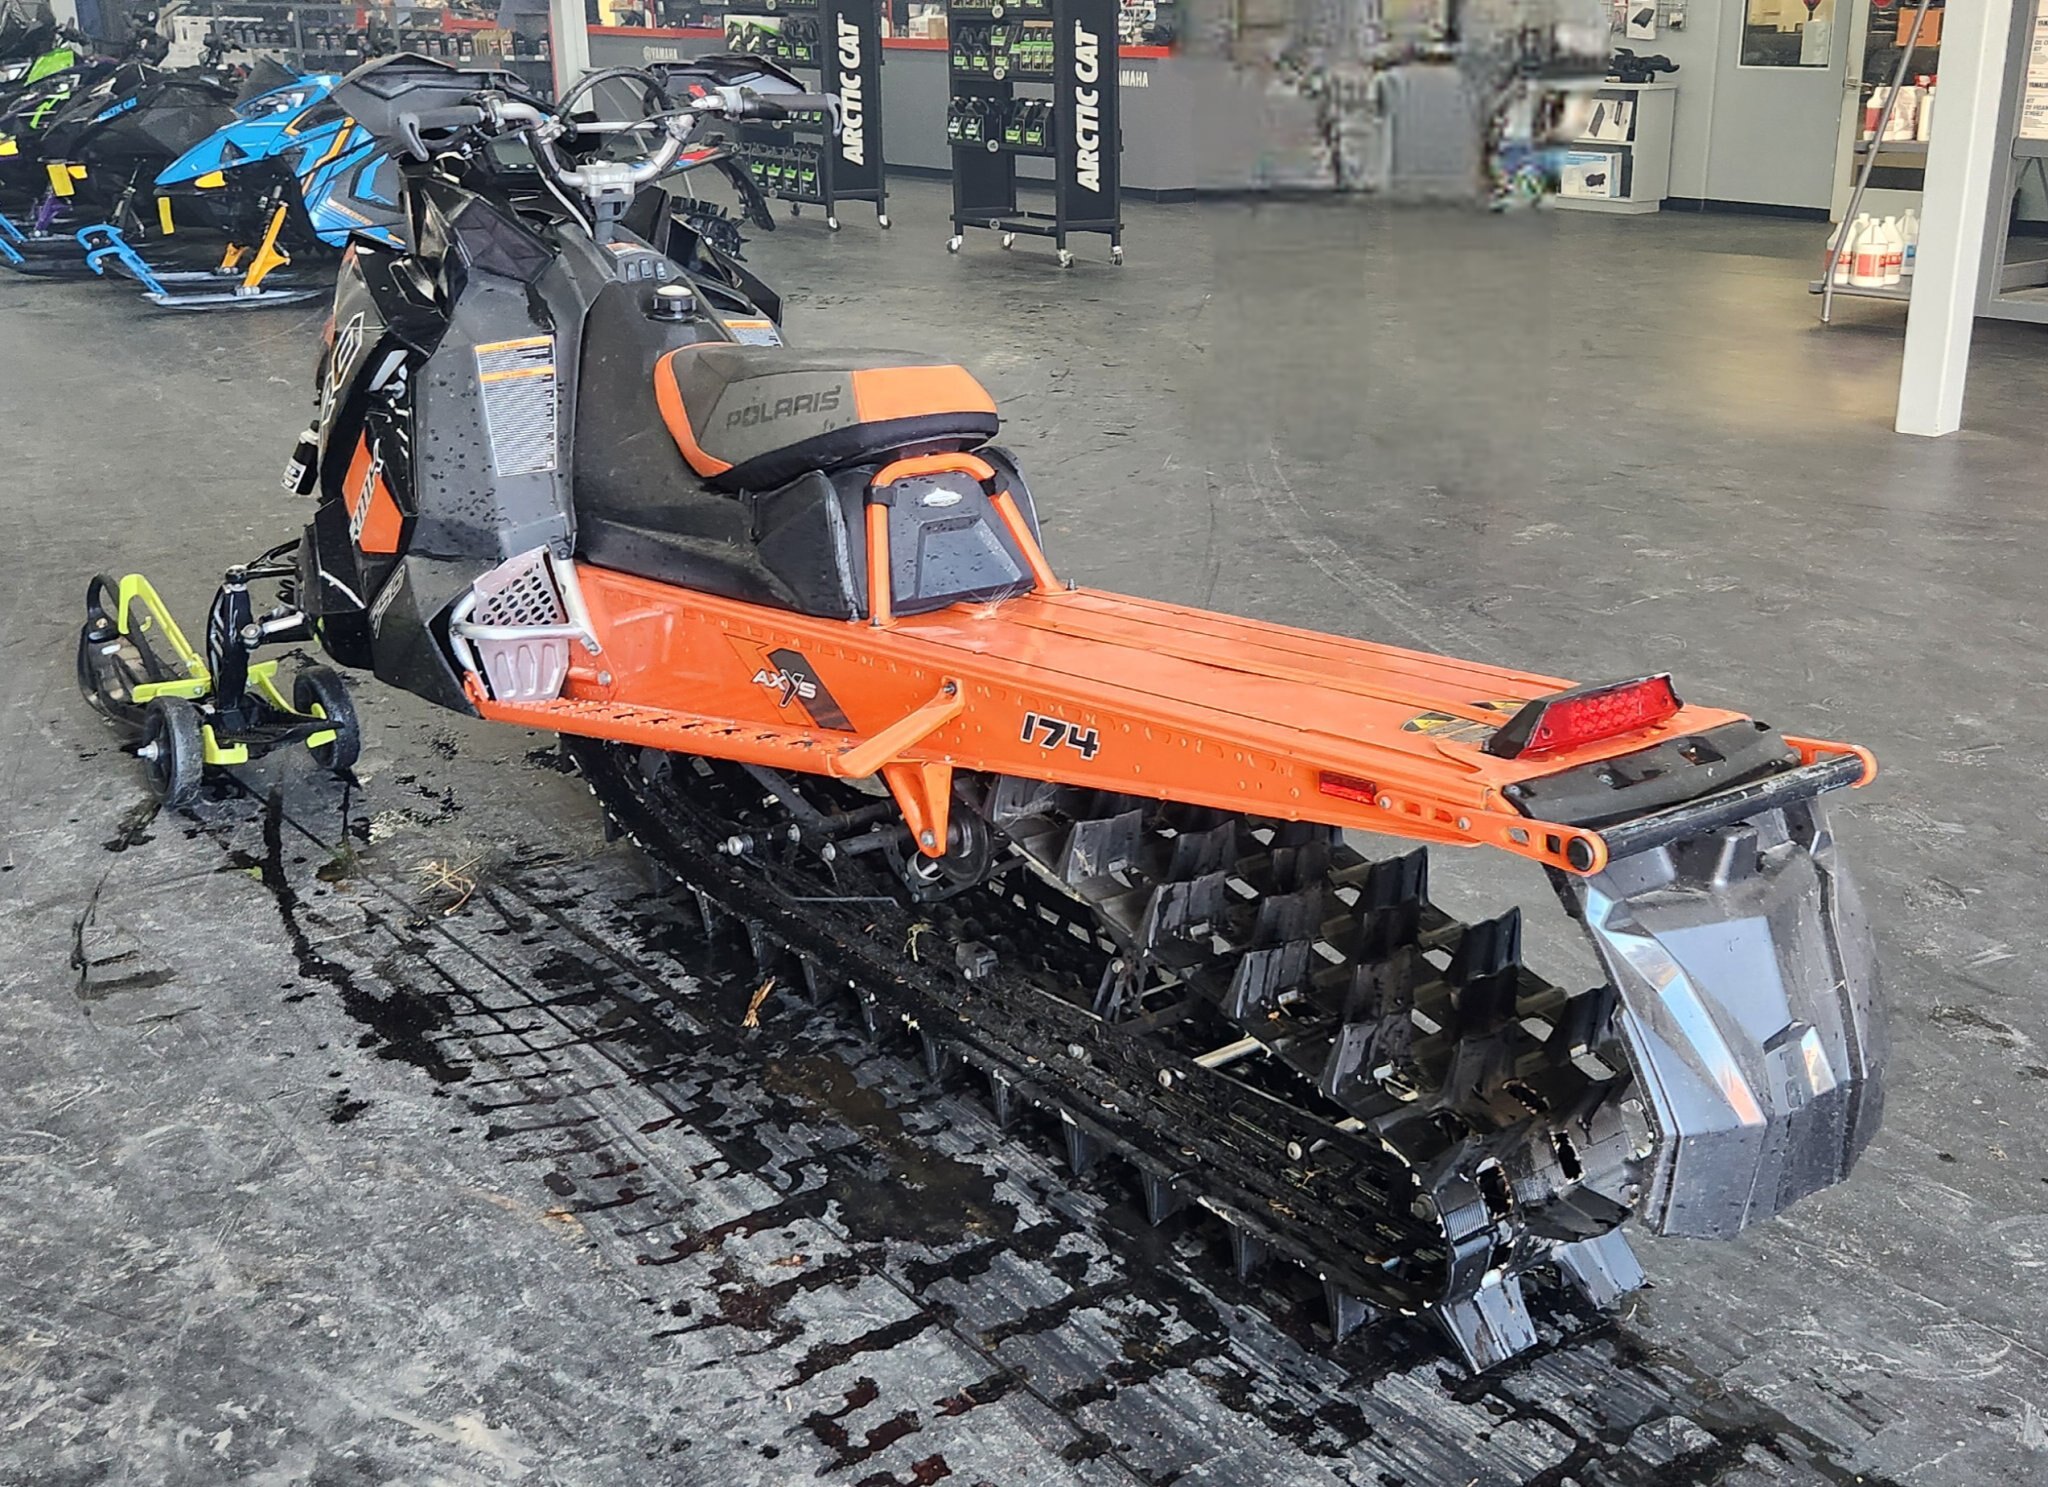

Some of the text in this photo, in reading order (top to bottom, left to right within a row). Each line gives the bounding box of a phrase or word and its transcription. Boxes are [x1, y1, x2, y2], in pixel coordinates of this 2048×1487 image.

[837, 19, 864, 166] ARCTIC CAT
[1119, 70, 1149, 88] MAHA
[1074, 25, 1100, 193] ARCTIC CAT
[726, 387, 841, 429] POLARIS
[752, 668, 817, 707] AXYS
[1020, 712, 1101, 760] 174
